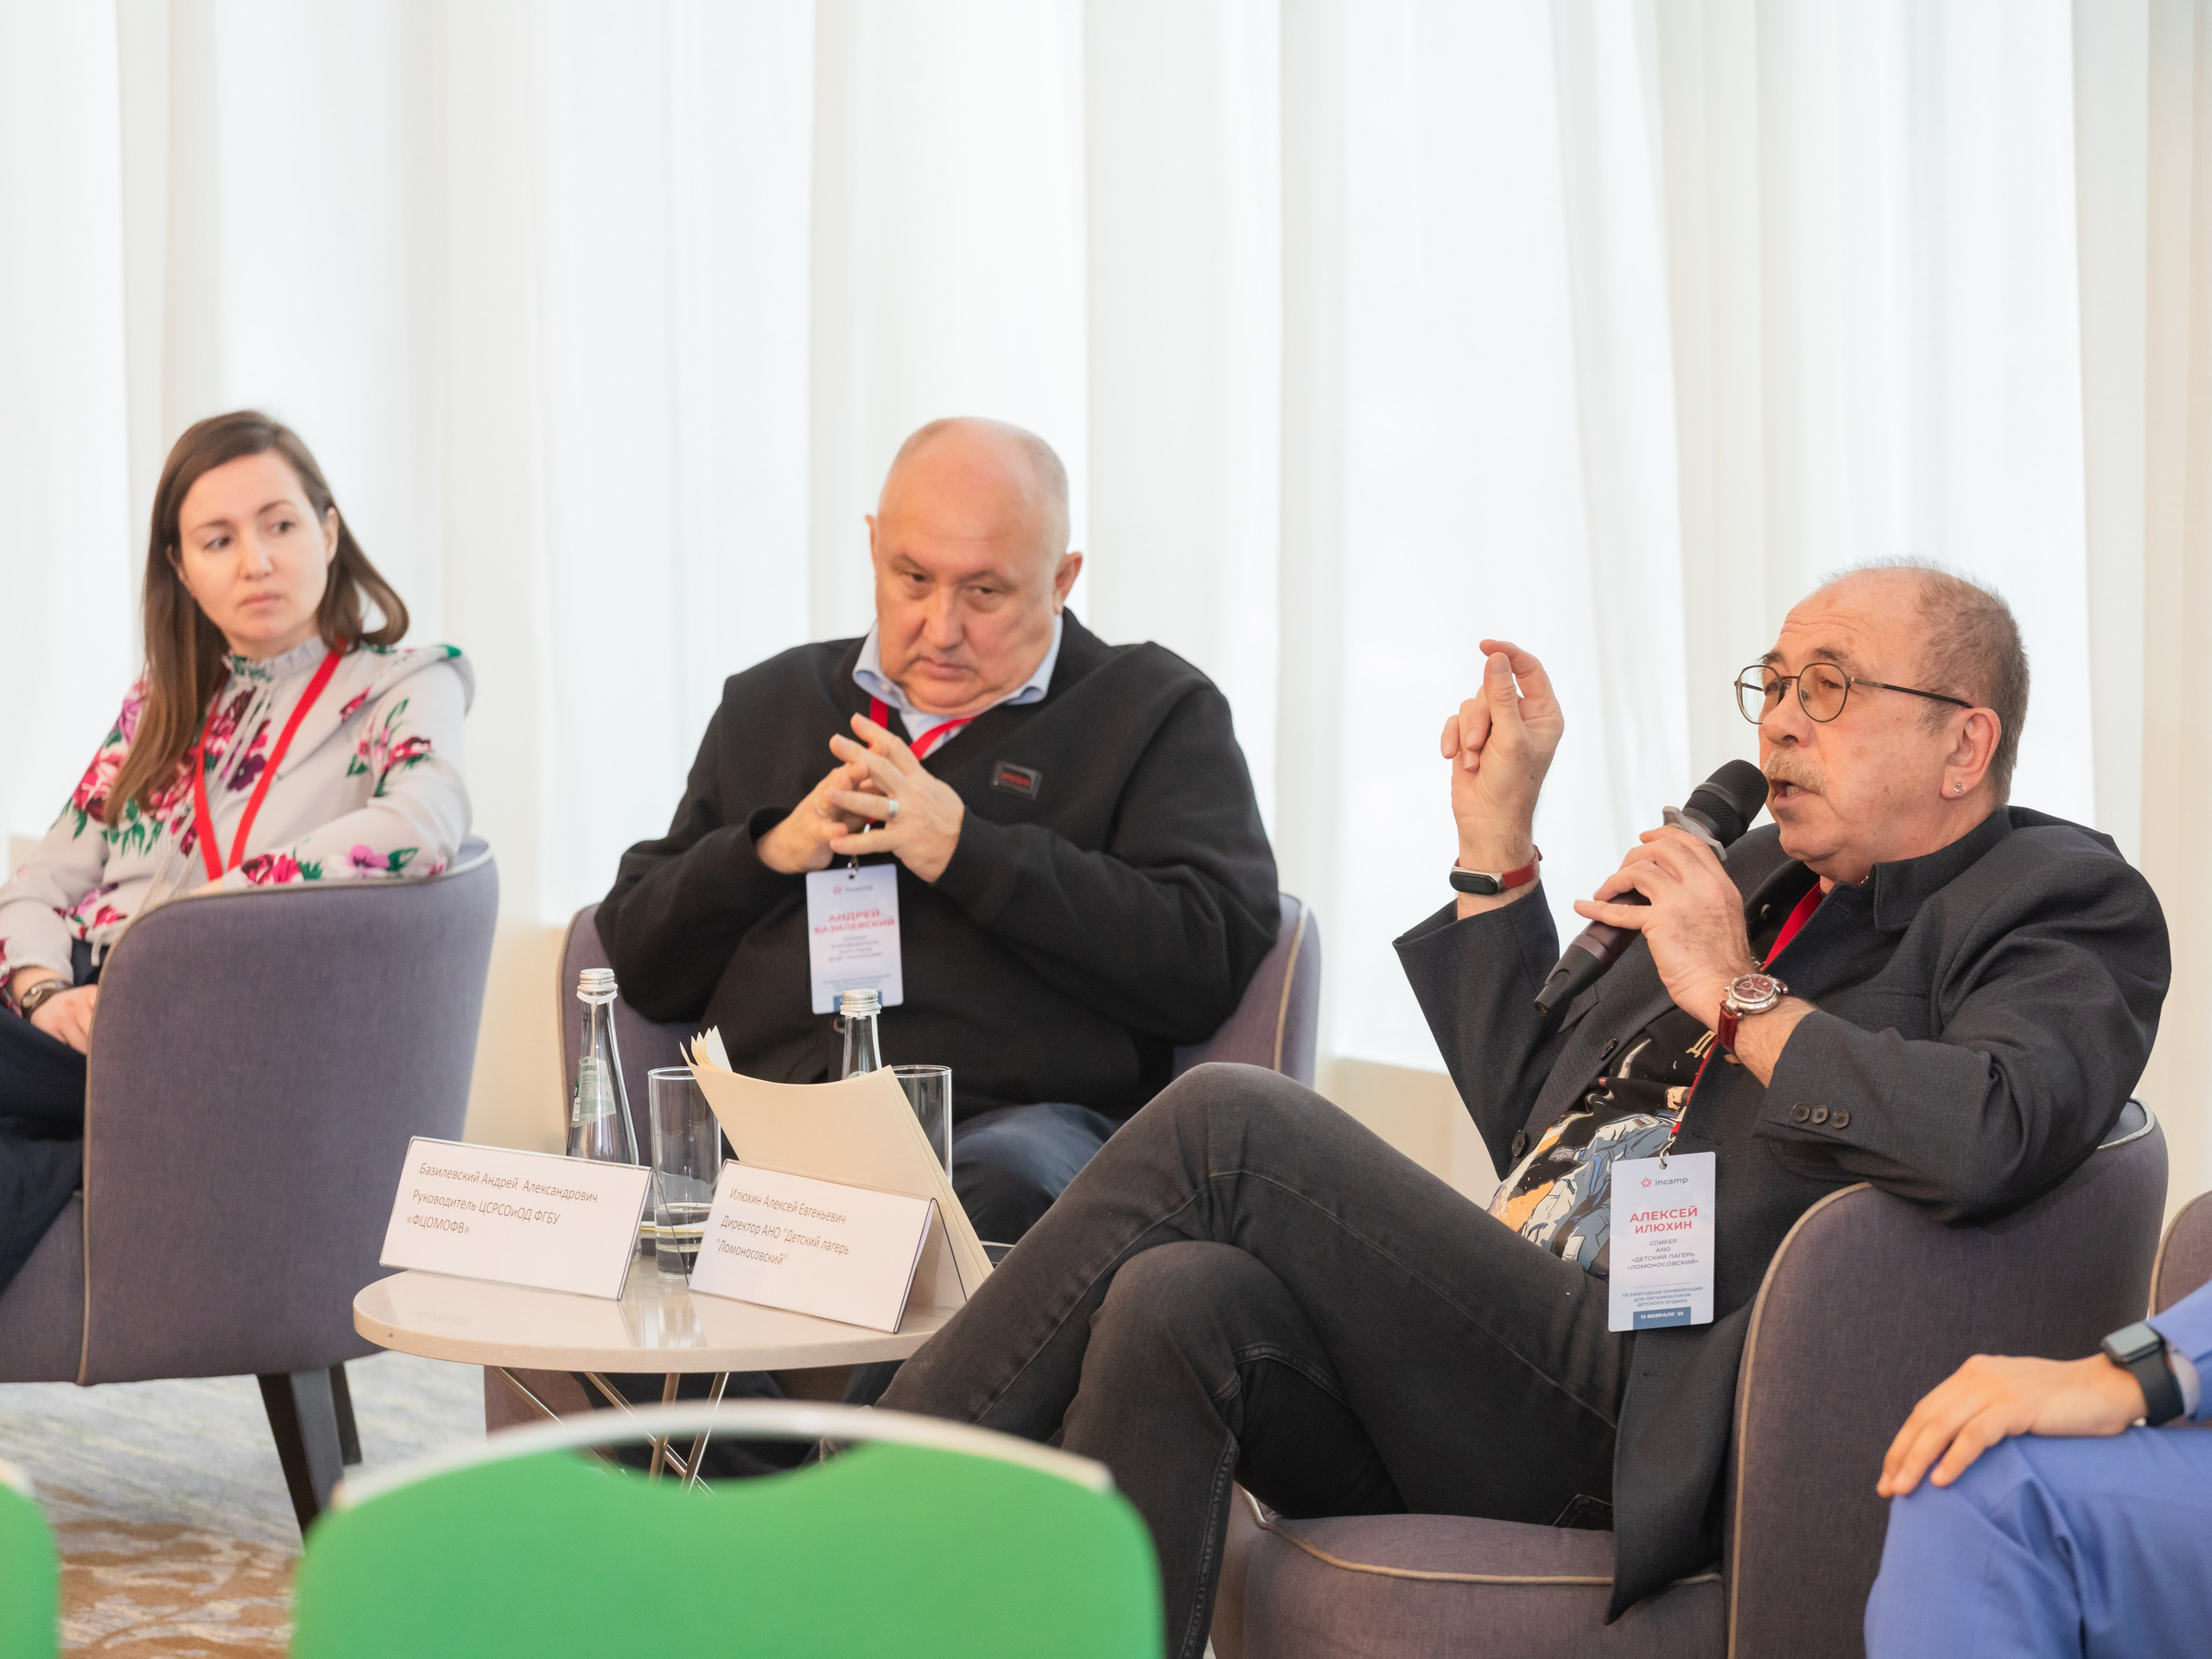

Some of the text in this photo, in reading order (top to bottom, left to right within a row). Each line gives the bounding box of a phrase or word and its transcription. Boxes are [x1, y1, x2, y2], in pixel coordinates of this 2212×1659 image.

[829, 908, 880, 922] АНДРЕЙ
[814, 918, 895, 933] БАЗИЛЕВСКИЙ
[419, 1162, 598, 1203] Базилевский Андрей Александрович
[412, 1189, 561, 1225] Руководитель ЦСРСОиОД ФГБУ
[729, 1187, 846, 1224] Илюхин Алексей Евгеньевич
[1630, 1205, 1698, 1223] АЛЕКСЕЙ
[721, 1215, 849, 1255] Директор АНО "Детский лагерь
[1635, 1220, 1692, 1234] ИЛЮХИН
[716, 1238, 788, 1266] "Ломоносовский"
[1631, 1254, 1667, 1263] «ДЕТСКИЙ
[1645, 1293, 1691, 1301] ОРГАНИЗАТОРОВ
[1663, 1286, 1703, 1294] КОНФЕРЕНЦИЯ
